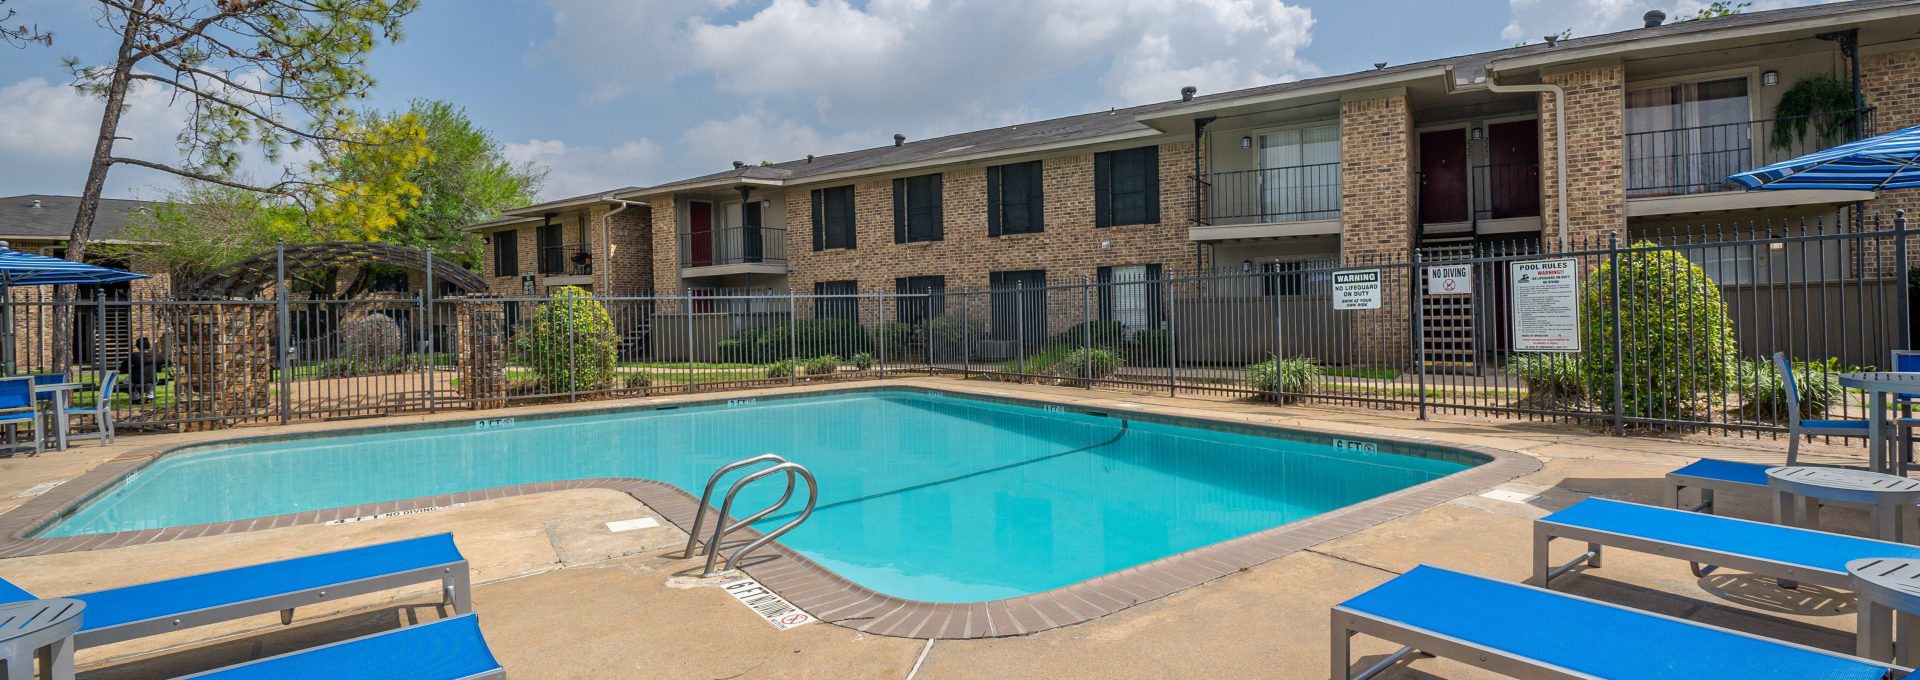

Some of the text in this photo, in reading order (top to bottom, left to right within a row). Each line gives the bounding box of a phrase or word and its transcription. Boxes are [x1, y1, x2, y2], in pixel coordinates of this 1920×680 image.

[1337, 273, 1375, 282] WARNING
[1433, 268, 1466, 278] NO DIVING
[403, 507, 437, 515] DIVING
[733, 587, 770, 599] FT
